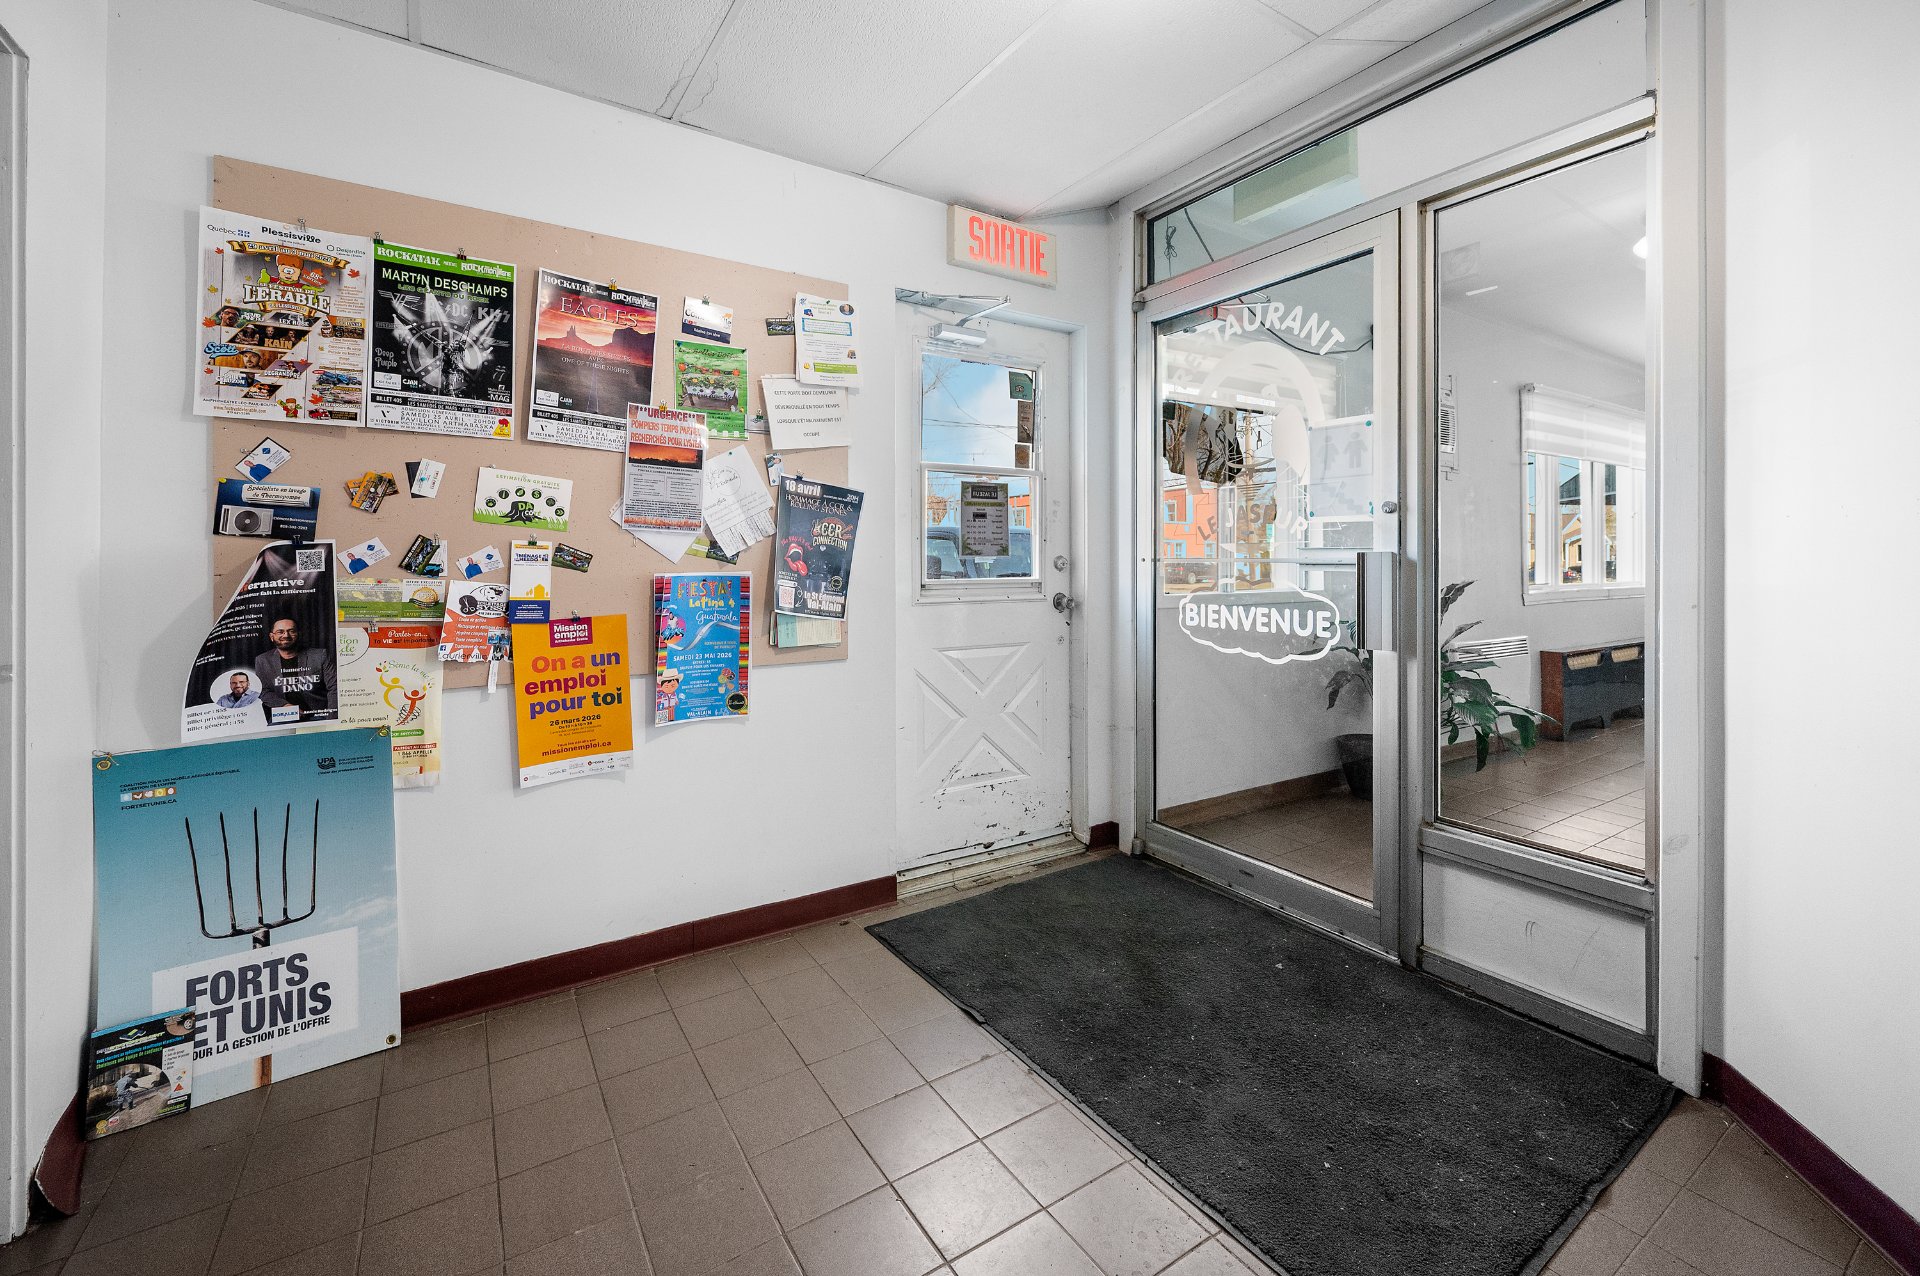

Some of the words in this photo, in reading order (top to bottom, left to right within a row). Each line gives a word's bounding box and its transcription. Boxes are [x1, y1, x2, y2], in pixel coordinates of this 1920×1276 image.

[261, 226, 321, 244] Plessisville
[968, 215, 1048, 278] SORTIE
[377, 246, 441, 266] ROCKATAK
[434, 277, 508, 298] DESCHAMPS
[544, 274, 594, 294] ROCKATAK
[560, 296, 638, 328] EAGLES
[204, 342, 238, 354] Scott
[264, 338, 292, 349] KAÏN
[1171, 301, 1346, 390] RETAURANT
[375, 348, 394, 358] Deep
[375, 356, 398, 370] Purple
[586, 362, 606, 370] THESE
[606, 366, 630, 374] NIGHTS
[401, 410, 430, 418] SAMEDI
[646, 406, 689, 422] URGENCE
[400, 416, 440, 424] PAVILLON
[442, 421, 494, 430] ARTHABASKA
[556, 426, 583, 434] SAMEDI
[631, 420, 660, 431] POMPIERS
[661, 422, 679, 433] TEMPS
[556, 430, 588, 439] PAVILLON
[590, 436, 625, 444] ARTHABAS
[630, 432, 667, 446] RECHERCHÉS
[667, 436, 683, 446] POUR
[496, 474, 531, 482] ESTIMATION
[246, 484, 280, 493] Spécialiste
[785, 480, 796, 492] 18
[798, 483, 822, 496] avril
[260, 492, 301, 500] Thermopompe
[786, 494, 821, 506] HOMMAGE
[829, 502, 844, 510] CCR
[518, 502, 533, 510] DA
[790, 500, 820, 512] ROLLING
[820, 505, 848, 516] STONES
[1197, 516, 1220, 540] LE
[1225, 503, 1308, 540] JASEUR
[822, 522, 842, 538] CCR
[812, 536, 848, 552] CONNECTION
[807, 598, 842, 612] Val-Alain
[695, 610, 739, 624] Guatemala
[1185, 604, 1332, 640] BIENVENUE
[554, 623, 588, 632] Mission
[554, 630, 588, 640] emploi
[438, 652, 488, 660] aurierville
[531, 656, 566, 674] On
[572, 656, 586, 670] a
[591, 652, 620, 667] un
[274, 674, 320, 686] ÉTIENNE
[524, 669, 607, 696] emploi
[283, 683, 313, 694] DANO
[529, 694, 586, 720] pour
[592, 687, 622, 706] toi
[204, 714, 232, 723] privilège
[204, 721, 228, 730] général
[560, 717, 580, 725] mars
[582, 714, 601, 722] 2026
[542, 740, 612, 758] missionemploi.ca
[316, 756, 336, 764] UPA
[120, 799, 178, 812] FORTSETUNIS.CA
[186, 952, 310, 1006] FORTS
[194, 1005, 234, 1048] ET
[241, 981, 332, 1034] UNIS
[193, 1046, 213, 1062] OUR
[216, 1040, 230, 1053] LA
[232, 1029, 275, 1050] GESTION
[277, 1026, 291, 1038] DE
[293, 1014, 330, 1034] L'OFFRE
[144, 1046, 163, 1056] confiance
